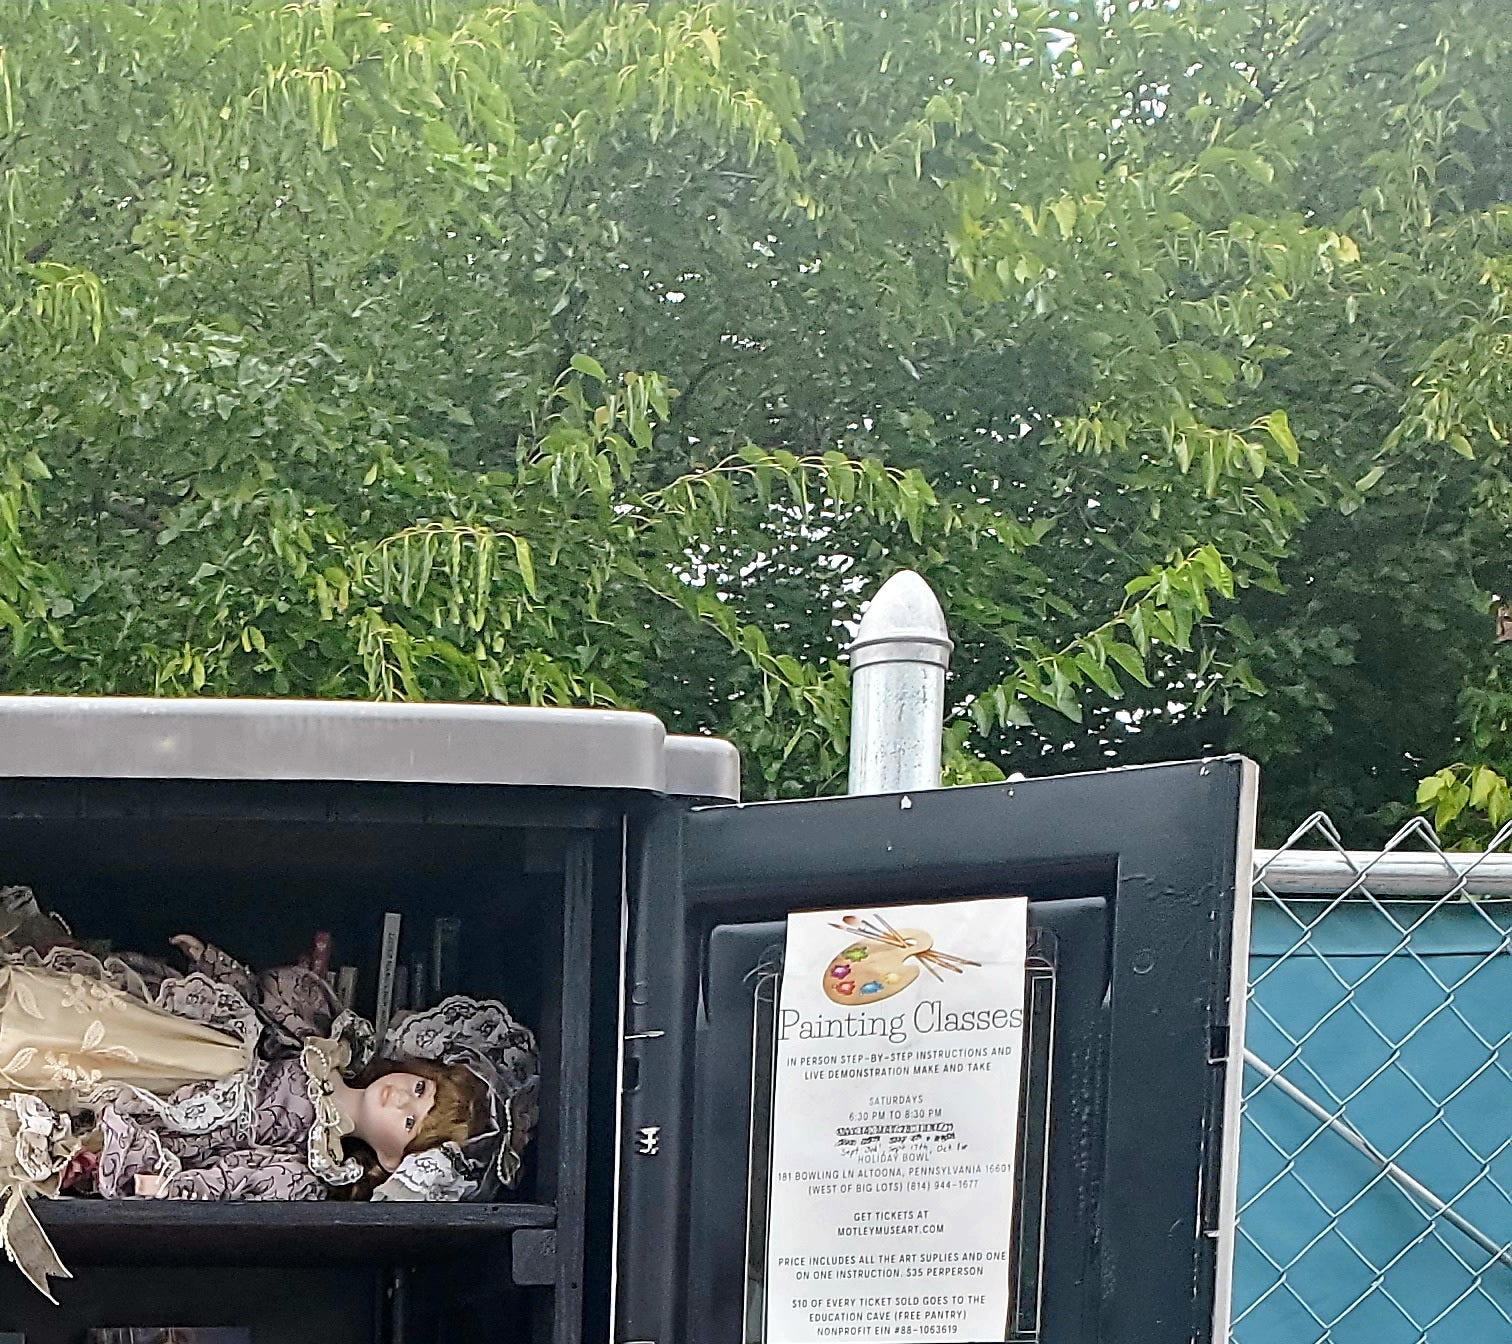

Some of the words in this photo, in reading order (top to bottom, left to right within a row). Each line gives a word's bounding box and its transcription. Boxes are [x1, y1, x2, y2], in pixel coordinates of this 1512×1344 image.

[778, 1009, 907, 1043] Painting
[914, 1000, 1023, 1033] Classes
[787, 1056, 797, 1067] IN
[800, 1056, 837, 1066] PERSON
[840, 1052, 913, 1064] STEP-BY-STEP
[916, 1049, 988, 1061] INSTRUCTIONS
[991, 1047, 1012, 1056] AND
[804, 1071, 825, 1081] LIVE
[828, 1066, 910, 1079] DEMONSTRATION
[913, 1065, 939, 1075] MAKE
[943, 1063, 964, 1073] AND
[967, 1062, 991, 1072] TAKE
[869, 1095, 923, 1106] SATURDAYS
[849, 1112, 869, 1121] 6:30
[872, 1111, 885, 1120] PM
[890, 1111, 902, 1120] TO
[904, 1110, 925, 1119] 8:30
[928, 1109, 942, 1118] PM
[858, 1154, 899, 1164] HOLIDAY
[902, 1153, 929, 1163] BOWL
[795, 1170, 839, 1180] BOWLING
[843, 1169, 855, 1179] LN
[857, 1167, 905, 1178] ALTOONA,
[908, 1164, 981, 1176] PENNSYLVANIA
[808, 1185, 837, 1195] (WEST
[840, 1185, 853, 1194] OF
[856, 1184, 872, 1193] BIG
[875, 1182, 903, 1193] LOTS)
[906, 1181, 931, 1191] (814)
[854, 1212, 872, 1221] GET
[875, 1211, 914, 1221] TICKETS
[916, 1210, 929, 1219] AT
[837, 1224, 944, 1236] MOTLEYMUSEART.COM
[778, 1257, 805, 1266] PRICE
[809, 1255, 856, 1265] INCLUDES
[859, 1254, 875, 1264] ALL
[878, 1254, 896, 1264] THE
[899, 1253, 917, 1263] ART
[920, 1252, 959, 1262] SUPLIES
[962, 1252, 984, 1261] AND
[986, 1251, 1006, 1261] ONE
[796, 1271, 810, 1280] ON
[813, 1270, 833, 1280] ONE
[926, 1266, 984, 1277] PERPERSON
[810, 1299, 823, 1308] OF
[826, 1298, 855, 1308] EVERY
[860, 1297, 892, 1307] TICKET
[895, 1296, 920, 1306] SOLD
[922, 1296, 948, 1305] GOES
[951, 1295, 964, 1304] TO
[968, 1295, 986, 1304] THE
[809, 1312, 863, 1322] EDUCATION
[866, 1311, 890, 1321] CAVE
[894, 1310, 921, 1321] (FREE
[924, 1310, 967, 1320] PANTRY)
[817, 1326, 872, 1336] NONPROFIT
[874, 1326, 891, 1335] EIN
